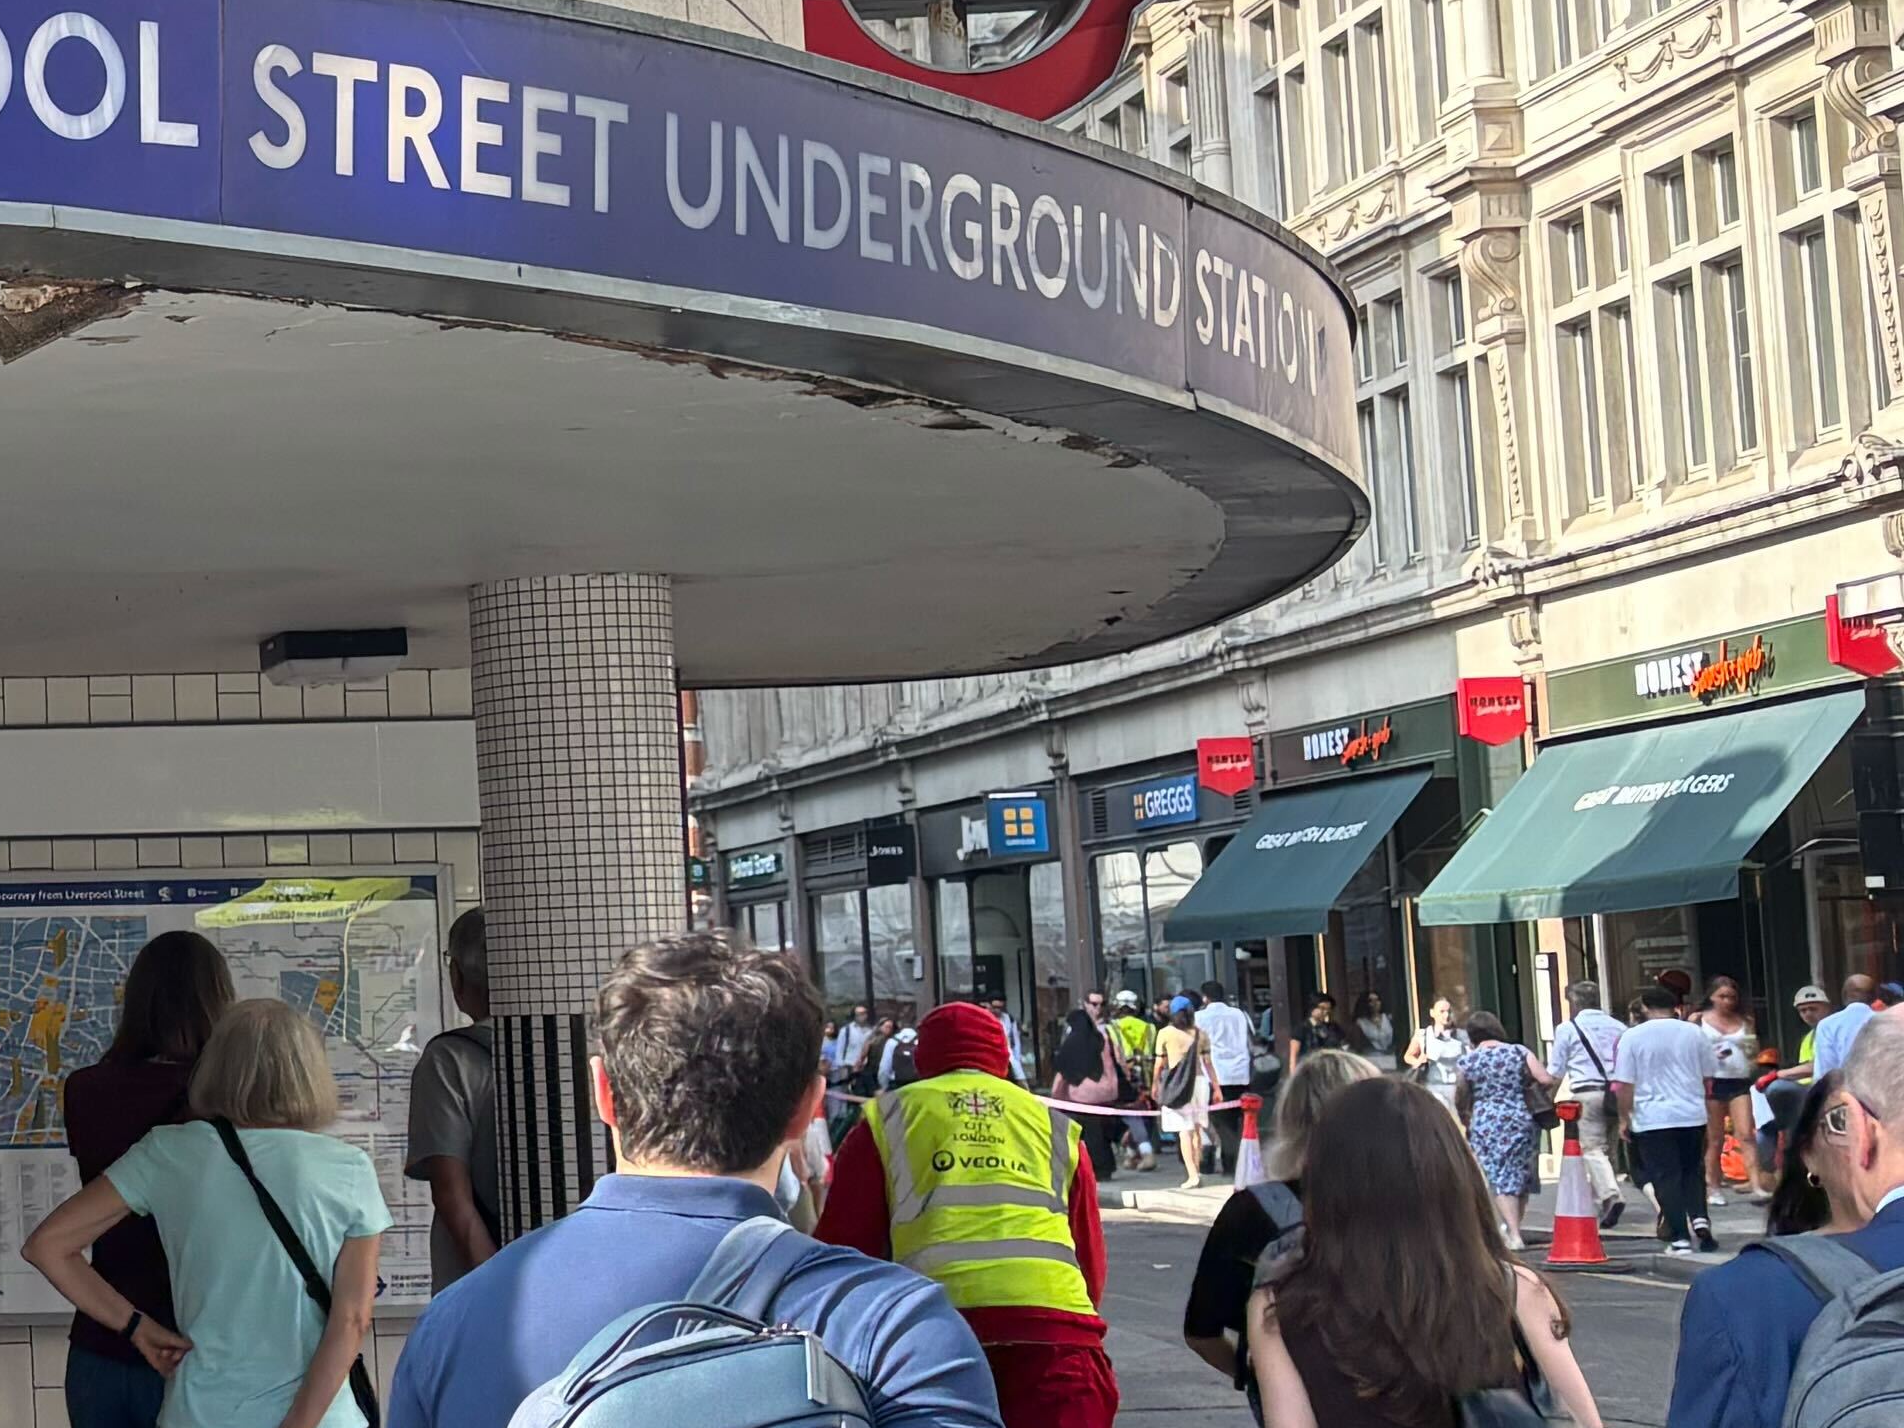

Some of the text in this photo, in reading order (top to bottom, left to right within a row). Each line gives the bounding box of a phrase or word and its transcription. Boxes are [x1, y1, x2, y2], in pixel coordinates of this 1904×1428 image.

[247, 43, 630, 214] STREET
[665, 111, 1180, 327] UNDERGROUND
[1195, 247, 1317, 397] STATION
[1634, 651, 1704, 696] HONEST
[1303, 727, 1350, 761] HONEST
[1144, 783, 1192, 819] GREGGS
[38, 890, 63, 901] from
[65, 889, 112, 902] Liverpool
[114, 888, 144, 900] Street
[953, 1132, 1006, 1145] LONDON
[964, 1121, 992, 1131] CITY
[958, 1156, 1030, 1173] VEOLIA
